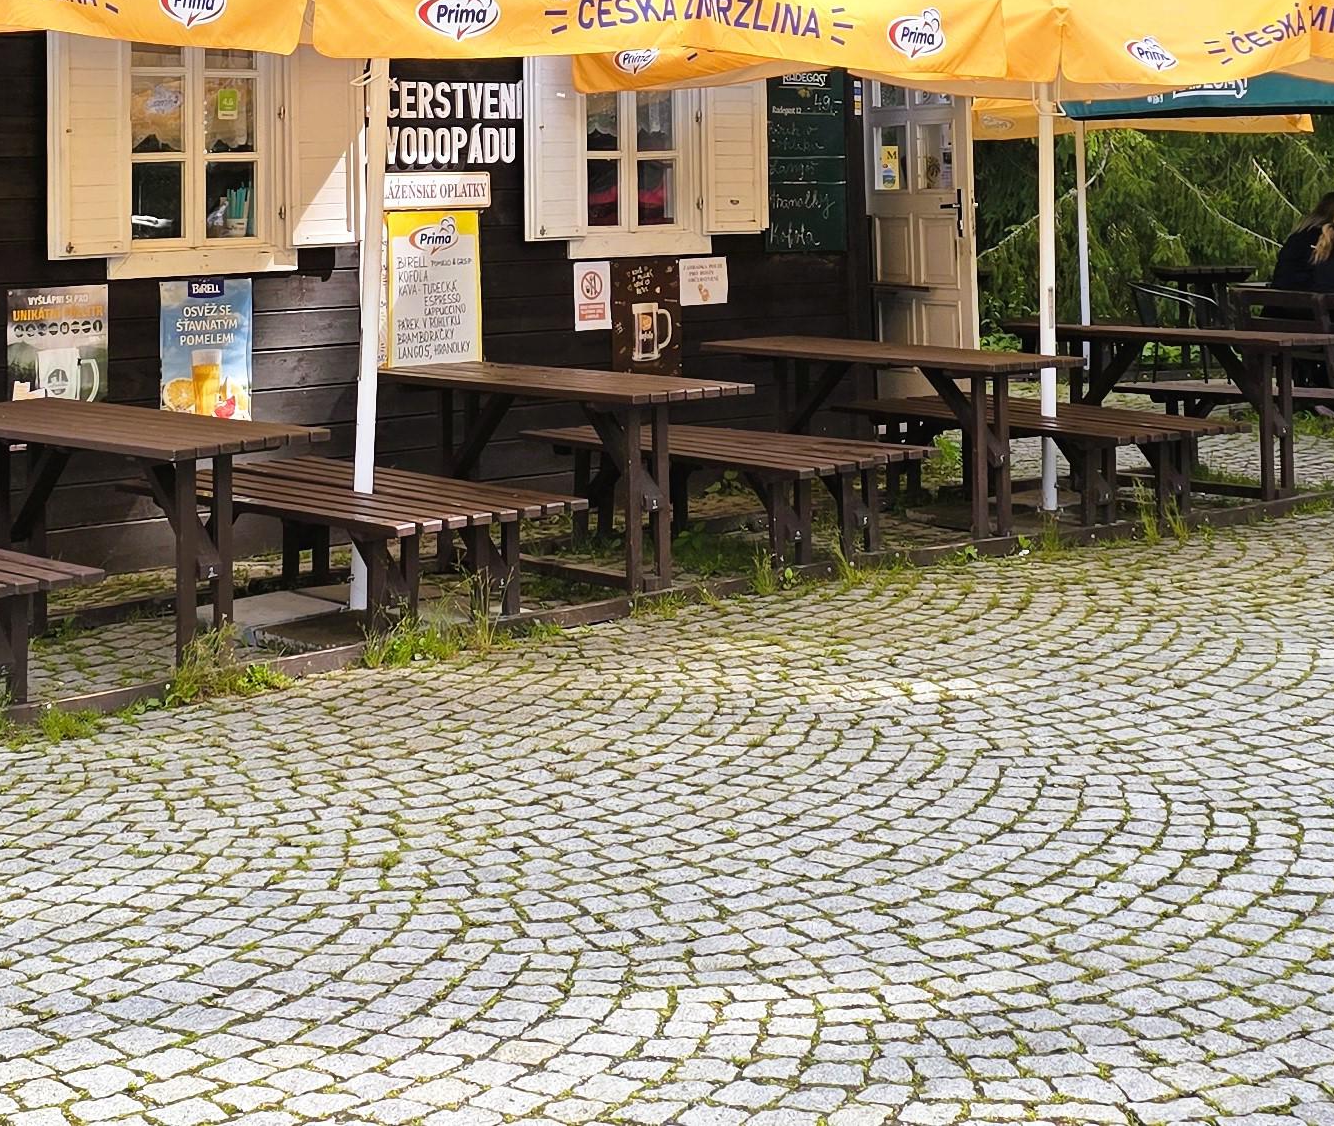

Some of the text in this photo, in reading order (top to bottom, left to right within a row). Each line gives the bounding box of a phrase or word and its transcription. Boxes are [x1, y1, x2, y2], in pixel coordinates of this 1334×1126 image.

[437, 3, 488, 24] Prima
[1226, 2, 1307, 55] ČESKÁ
[900, 25, 937, 47] Prima
[783, 73, 828, 86] RADEGAST
[387, 77, 524, 120] ČERSTVENÍ
[387, 123, 516, 165] VODOPÁDU
[384, 178, 487, 200] ÁZEŇSKÉ OPLATKY
[419, 232, 452, 245] Prima
[397, 255, 428, 269] BIRELL
[398, 269, 428, 283] KOFOLA
[424, 293, 461, 307] ESPRESSO
[183, 303, 232, 317] OSVĚŽ SE
[424, 303, 466, 316] CAPPUCCINO
[176, 317, 238, 332] ŠŤAVNATÝM
